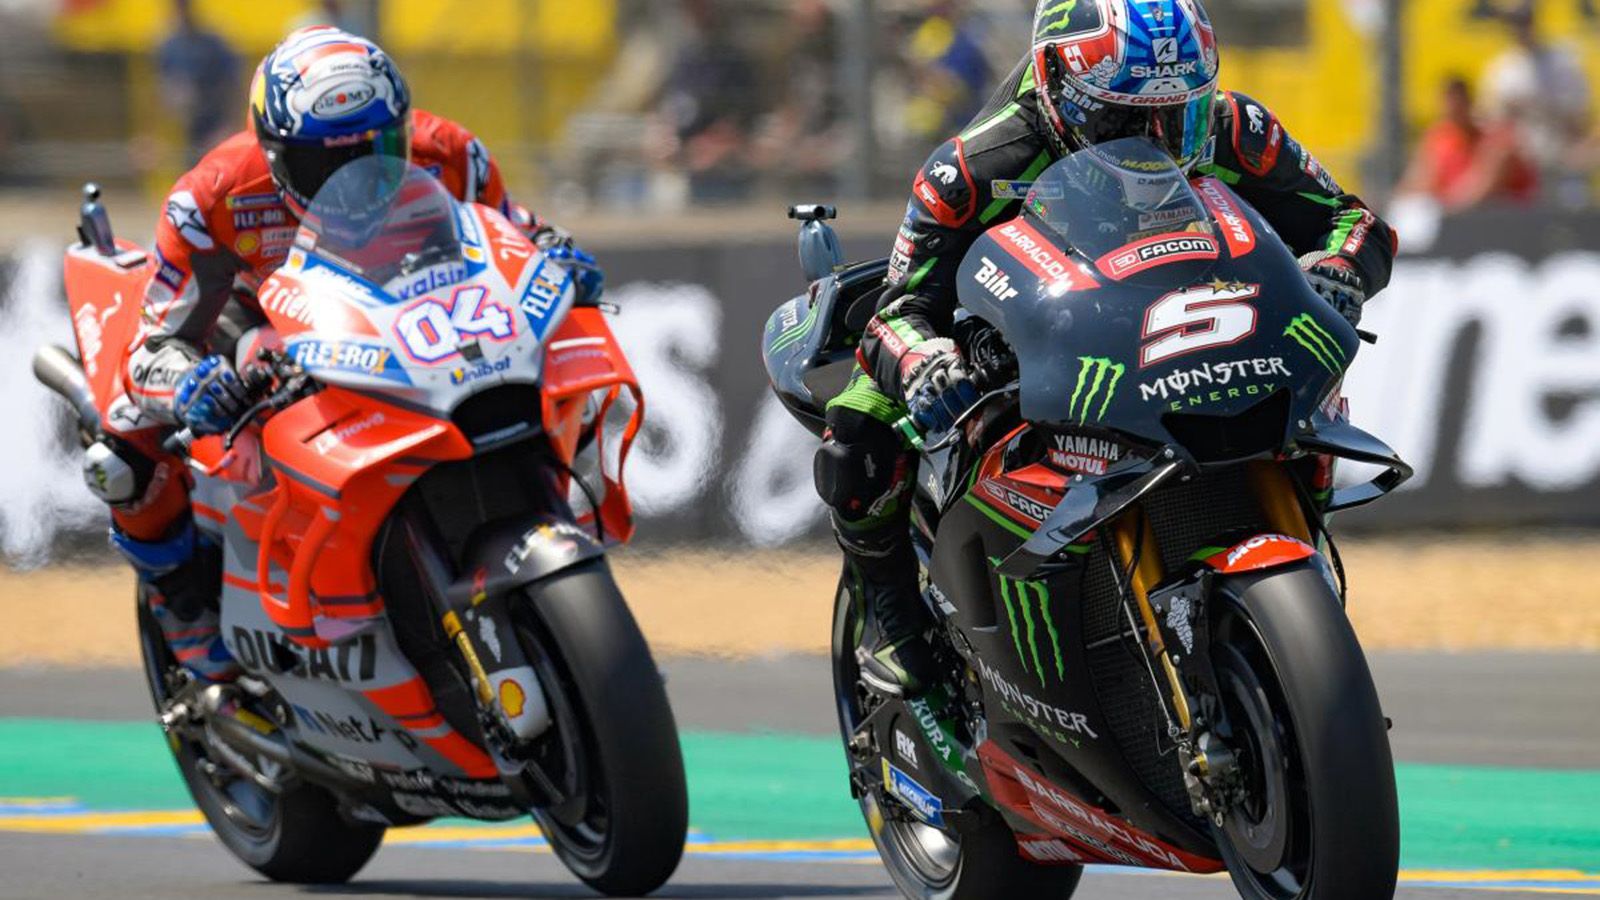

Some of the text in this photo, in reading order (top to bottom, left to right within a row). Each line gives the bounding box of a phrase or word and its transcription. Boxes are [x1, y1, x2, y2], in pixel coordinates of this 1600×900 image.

[1130, 61, 1197, 79] SHARK
[1061, 80, 1104, 112] Bihr
[1130, 93, 1188, 105] GRAND
[999, 225, 1074, 291] BARRACUDA
[1140, 239, 1213, 260] FACOM
[974, 256, 1019, 301] Bihr
[392, 285, 517, 365] 04
[1139, 283, 1261, 369] 5
[451, 356, 512, 385] Unibat
[1139, 357, 1292, 402] MONSTER
[1170, 383, 1276, 412] ENERGY
[1052, 451, 1106, 475] MOTUL
[1054, 434, 1119, 461] YAMAHA
[233, 625, 376, 682] DUATI
[978, 656, 1098, 739] MONSTER
[911, 697, 951, 761] KURA
[1014, 766, 1190, 872] BARRACUDA
